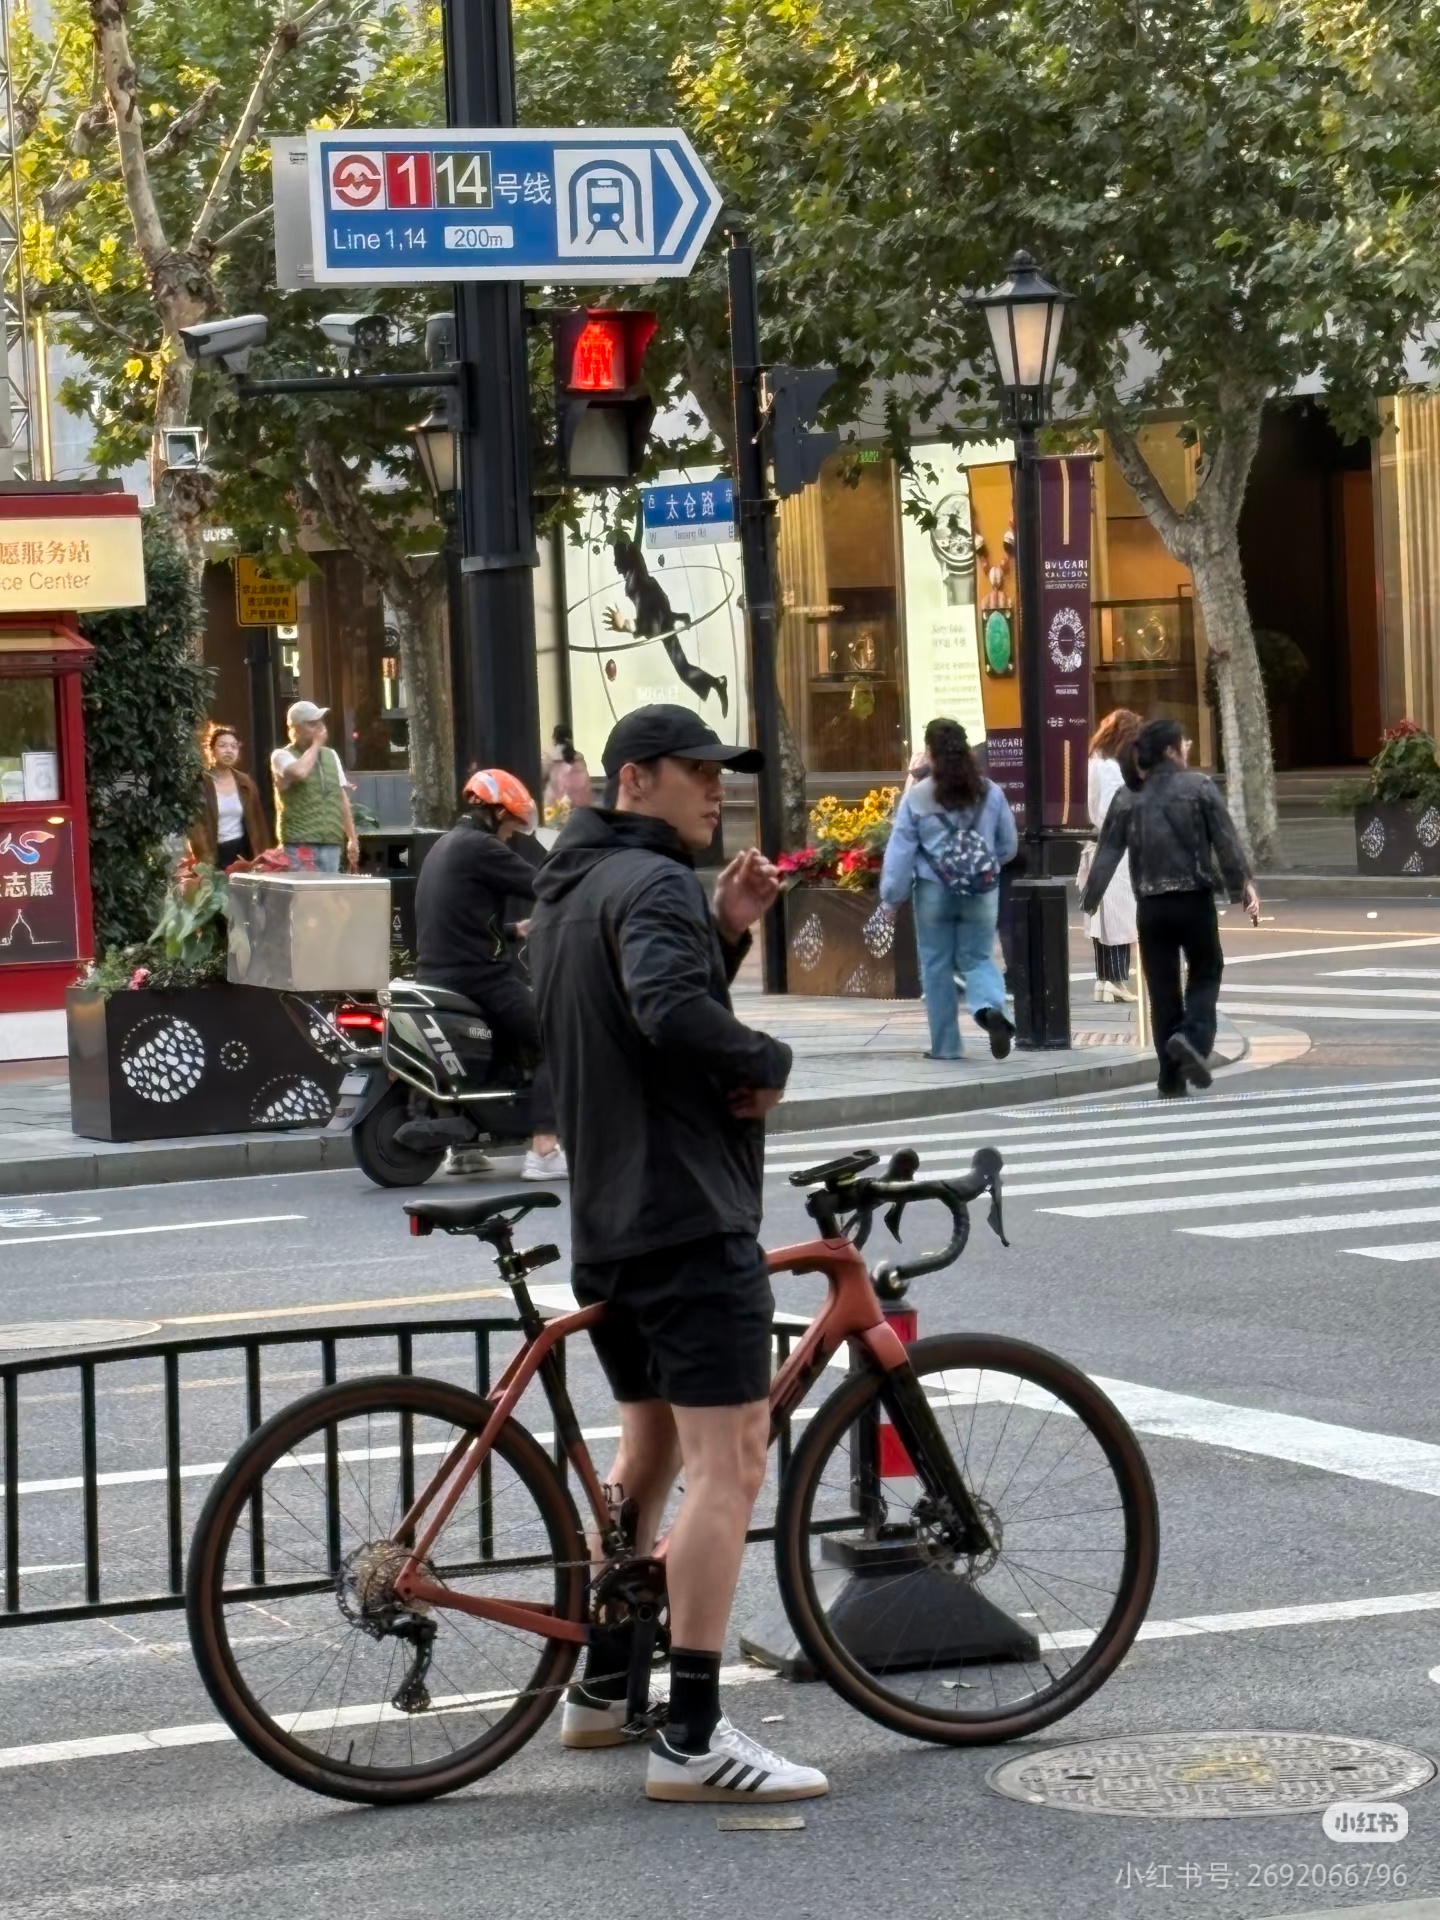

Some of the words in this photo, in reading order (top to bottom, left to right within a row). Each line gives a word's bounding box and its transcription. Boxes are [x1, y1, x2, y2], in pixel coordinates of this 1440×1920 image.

[397, 155, 417, 205] 1
[436, 155, 488, 205] 14
[494, 173, 552, 205] 号线
[333, 228, 381, 250] Line
[385, 228, 428, 251] 1,14
[454, 228, 503, 248] 200m
[666, 490, 715, 520] 太仓路
[1044, 560, 1088, 570] BVLGARI
[29, 571, 91, 590] Center
[0, 871, 54, 898] 志愿
